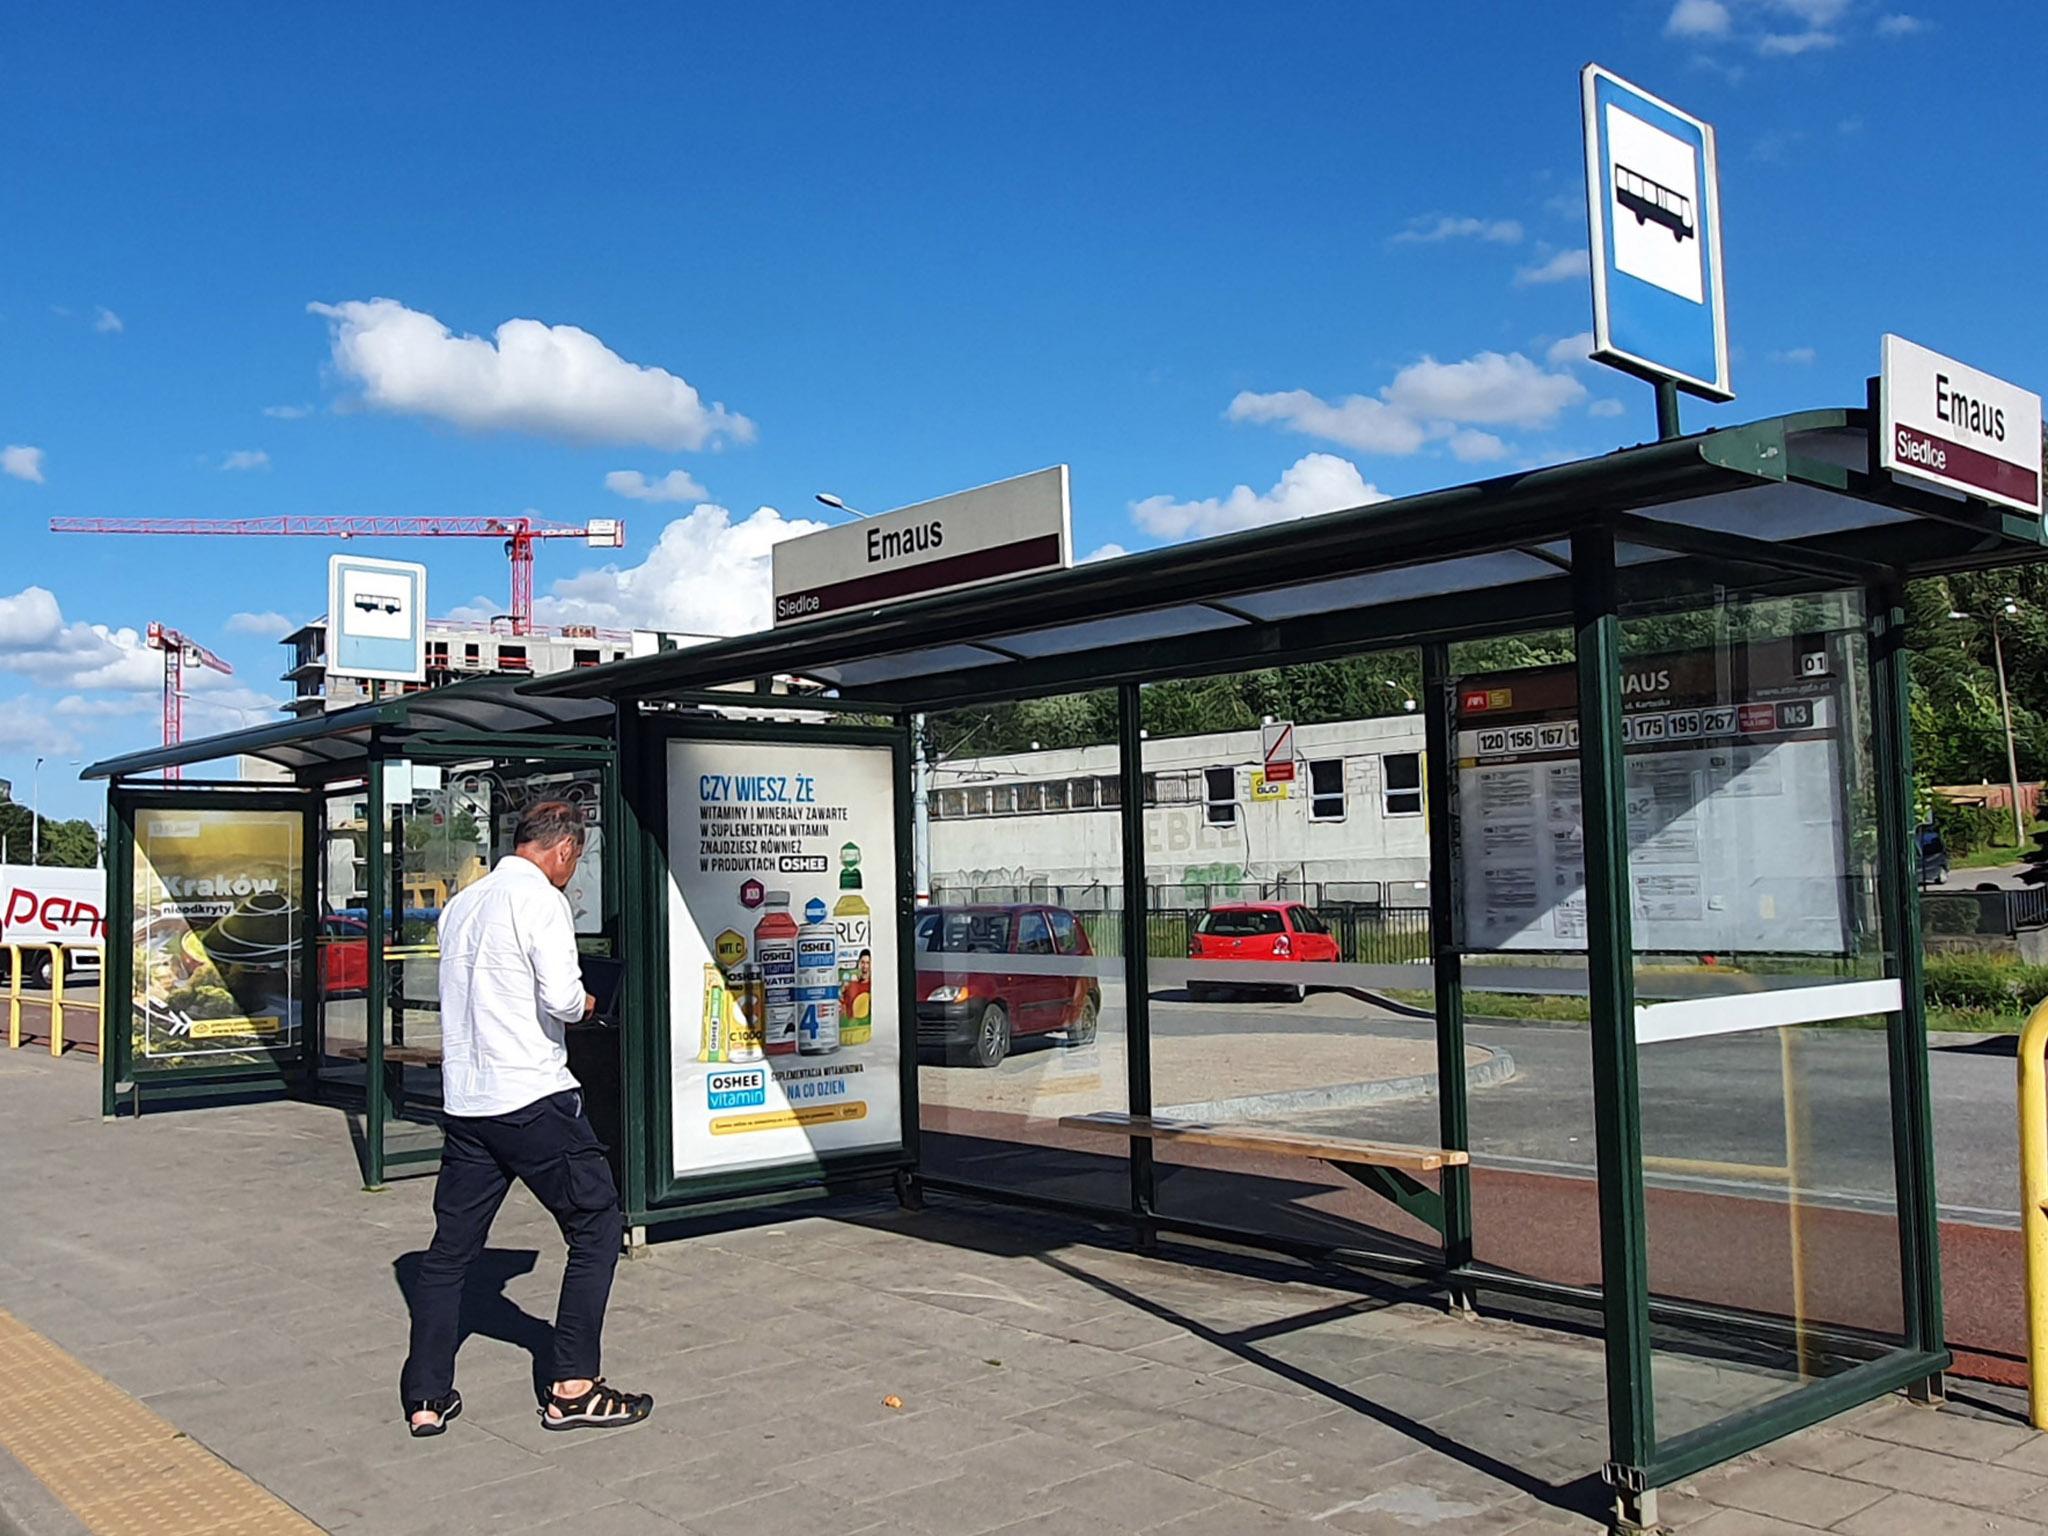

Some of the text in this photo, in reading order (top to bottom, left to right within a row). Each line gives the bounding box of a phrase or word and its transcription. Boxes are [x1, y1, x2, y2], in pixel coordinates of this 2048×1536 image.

[1936, 373, 2005, 442] Emaus
[1897, 431, 1947, 470] Siedlce
[867, 521, 943, 563] Emaus
[777, 594, 820, 617] Siedlce
[1805, 657, 1823, 671] 01
[1620, 670, 1670, 694] AUS
[1481, 733, 1503, 750] 120
[1510, 731, 1533, 748] 156
[1540, 729, 1562, 745] 167
[1637, 717, 1663, 735] 175
[1670, 714, 1698, 733] 195
[1704, 713, 1734, 731] 267
[1784, 705, 1807, 724] N3
[700, 773, 815, 804] CZY WIESZ, ŻE
[700, 806, 848, 820] WITAMINY I MINERAŁY ZAWARTE
[700, 823, 829, 837] W SUPLEMENTACH WITAMIN
[700, 838, 802, 854] ZNAJDZIESZ RÓWNIEŻ
[700, 858, 825, 872] W PRODUKTACH OSHEE
[161, 874, 279, 897] Kraków
[163, 903, 232, 915] nieodkryty
[801, 943, 831, 952] OSHEE
[763, 952, 791, 961] OSHEE
[713, 1074, 759, 1089] OSHEE
[710, 1090, 764, 1107] vitamin
[787, 1084, 800, 1099] NA
[803, 1082, 815, 1098] CO
